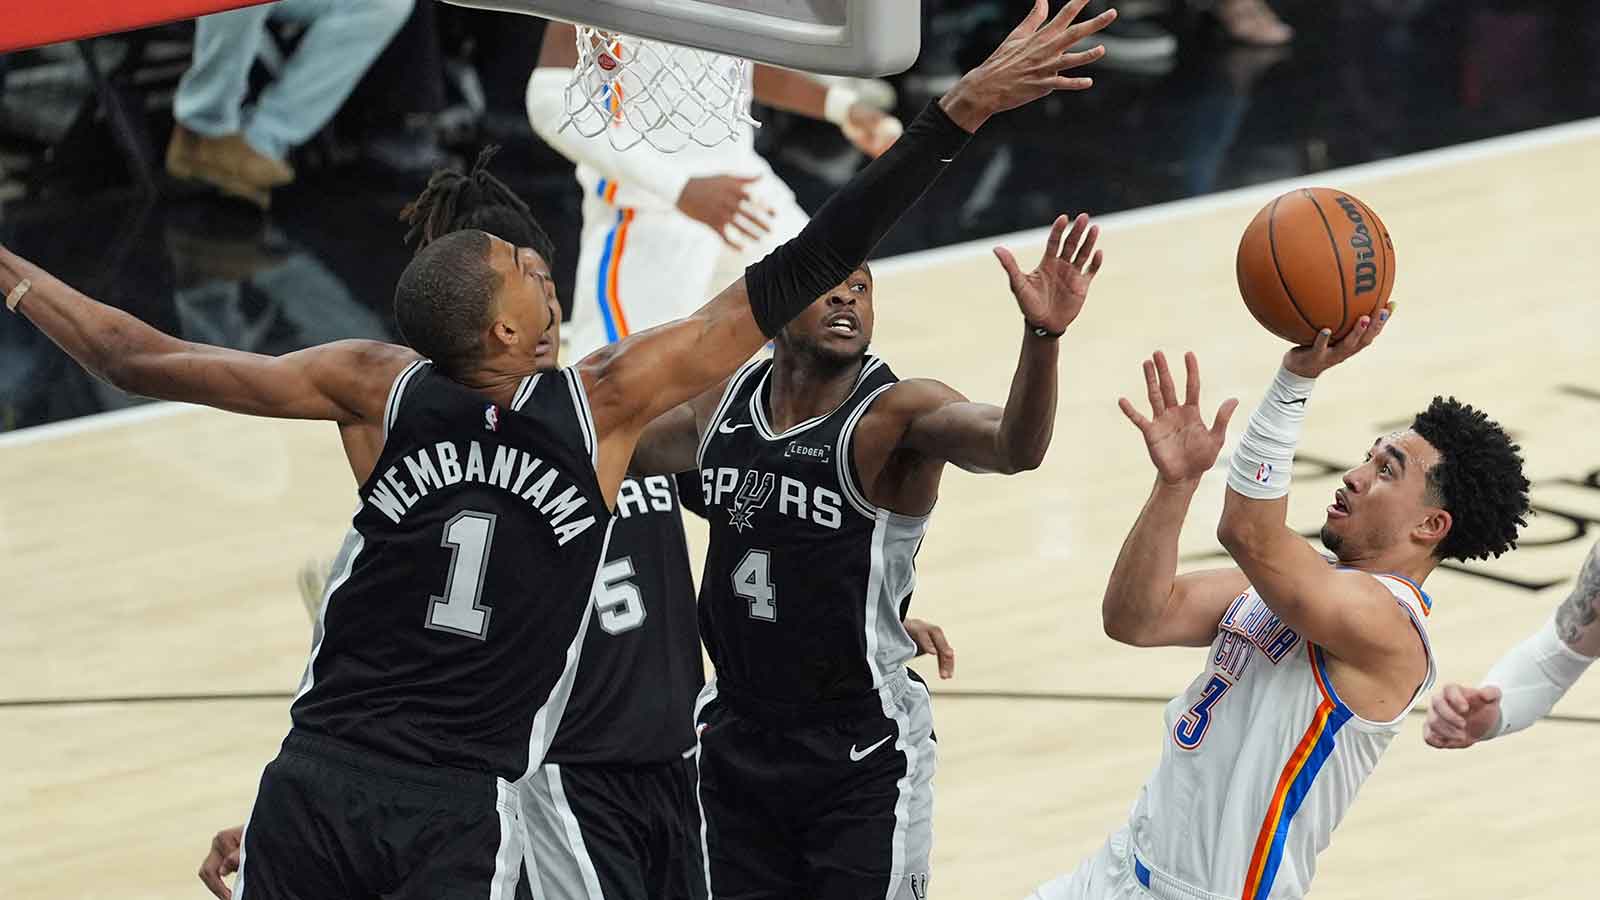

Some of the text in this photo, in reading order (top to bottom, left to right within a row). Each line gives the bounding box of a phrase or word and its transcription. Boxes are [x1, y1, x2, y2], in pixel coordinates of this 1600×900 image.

[1336, 196, 1377, 297] Wilson
[790, 444, 824, 457] LEDGER
[368, 441, 596, 547] WEMBANYAMA
[617, 475, 673, 518] RS
[424, 510, 497, 641] 1
[594, 556, 647, 636] 5
[731, 549, 776, 622] 4
[1214, 630, 1255, 681] CITY
[1174, 673, 1232, 750] 3
